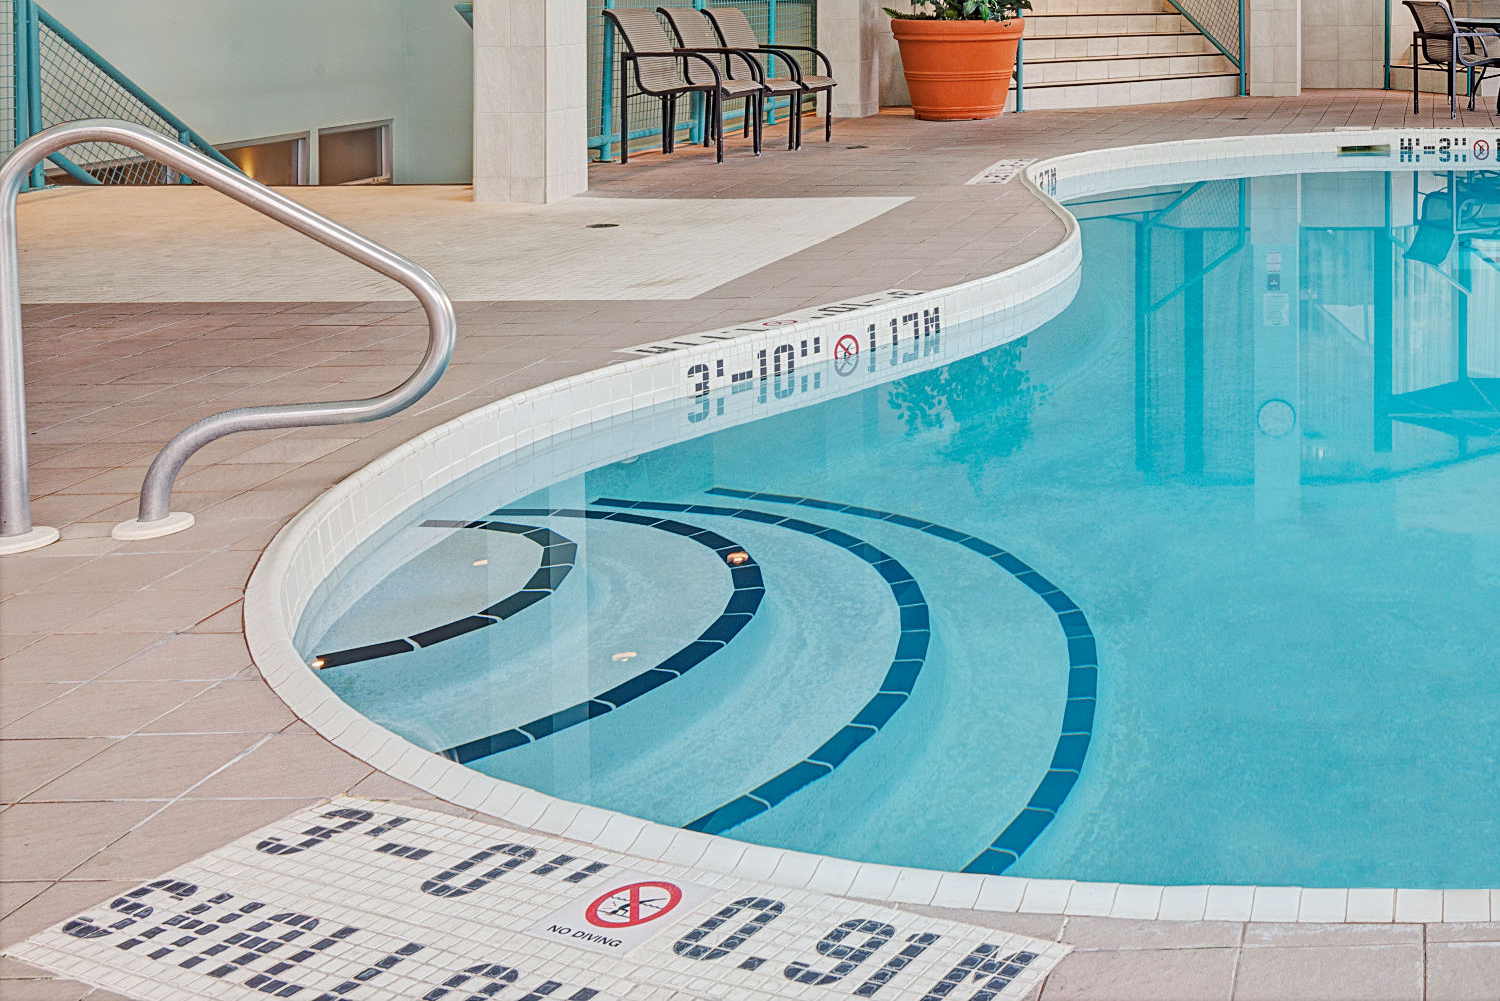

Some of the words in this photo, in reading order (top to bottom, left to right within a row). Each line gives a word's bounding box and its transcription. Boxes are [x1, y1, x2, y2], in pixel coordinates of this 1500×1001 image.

[256, 808, 609, 898] 3'-0"
[673, 896, 1040, 1001] 0.91M
[546, 924, 572, 935] NO
[571, 930, 622, 948] DIVING
